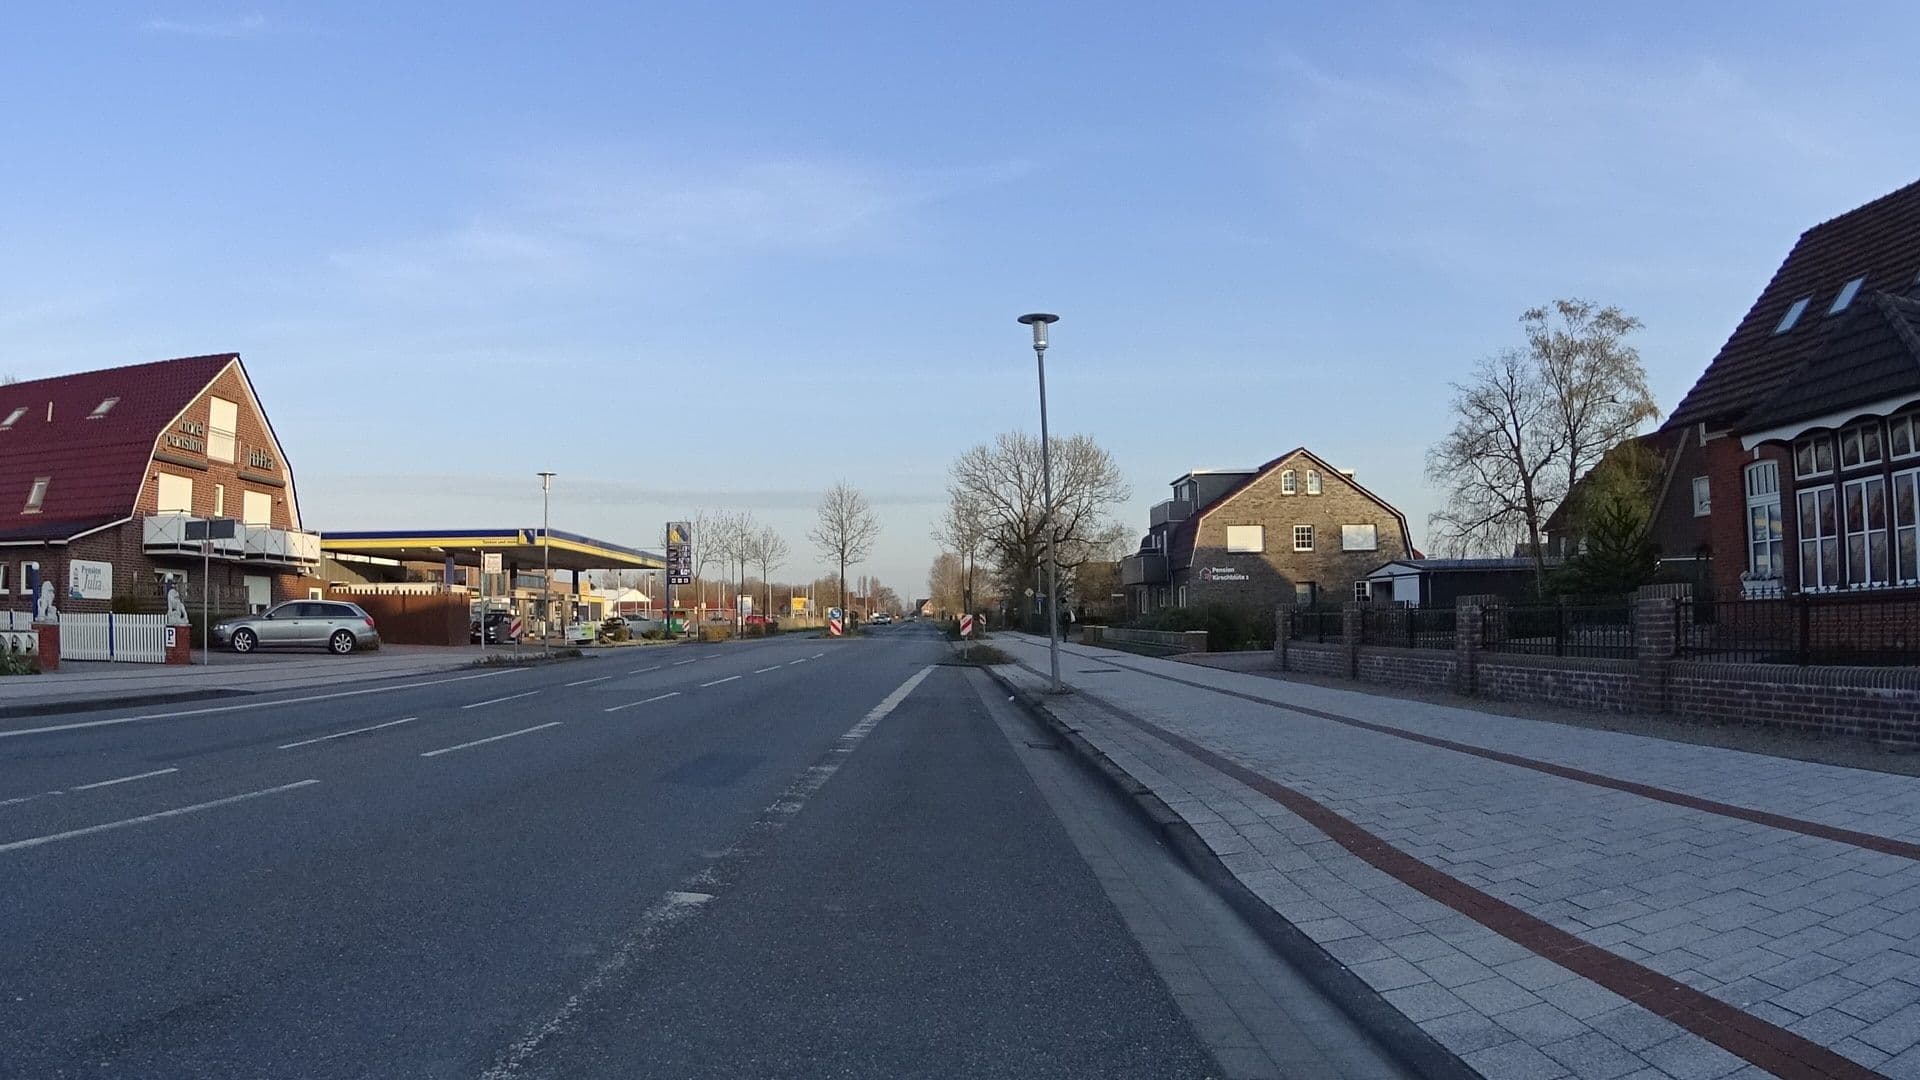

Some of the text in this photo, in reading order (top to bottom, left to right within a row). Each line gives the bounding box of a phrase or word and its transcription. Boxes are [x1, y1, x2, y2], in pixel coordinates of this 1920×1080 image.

[163, 431, 204, 454] pension
[81, 565, 102, 576] Pension
[81, 574, 102, 592] Julia
[168, 629, 174, 641] P
